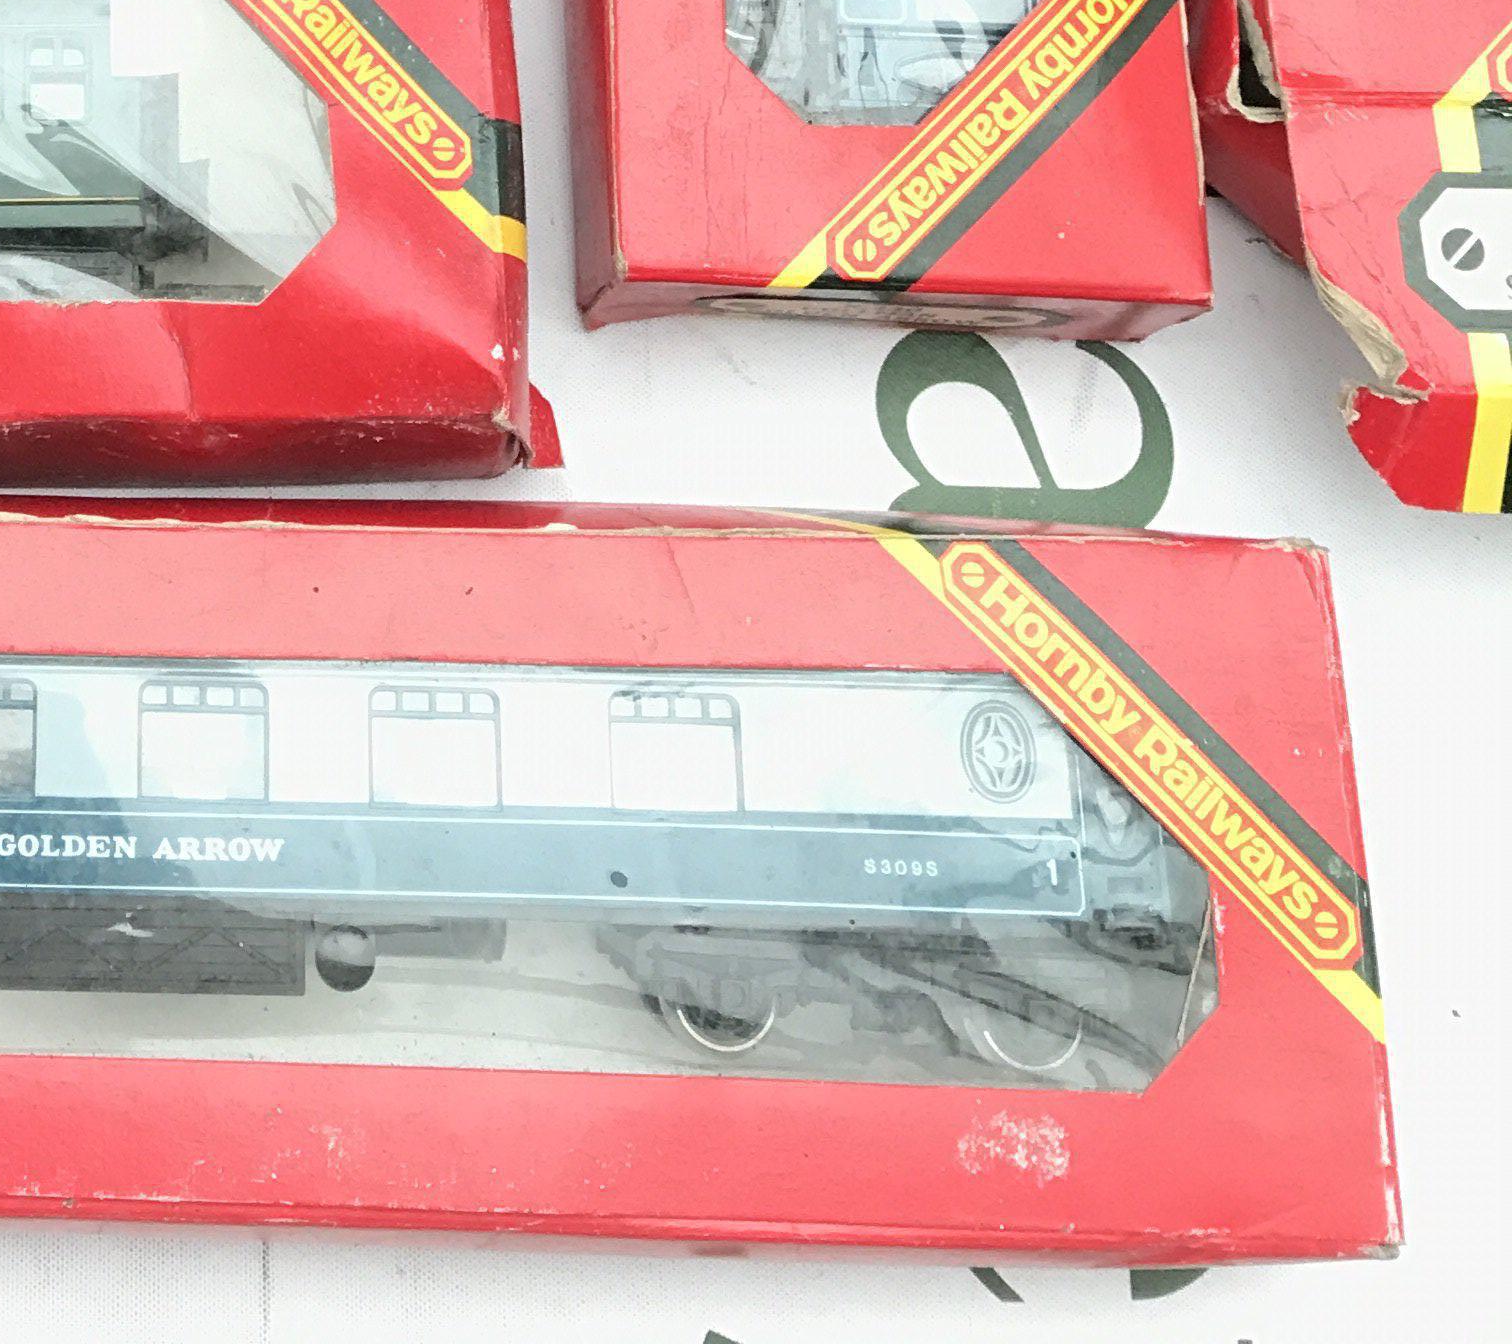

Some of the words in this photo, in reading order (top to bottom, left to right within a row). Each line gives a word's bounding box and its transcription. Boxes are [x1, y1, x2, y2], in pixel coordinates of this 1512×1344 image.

[868, 87, 1030, 247] Railways
[979, 575, 1141, 736] Hornby
[1133, 723, 1319, 920] Railways
[153, 835, 285, 863] ARROW
